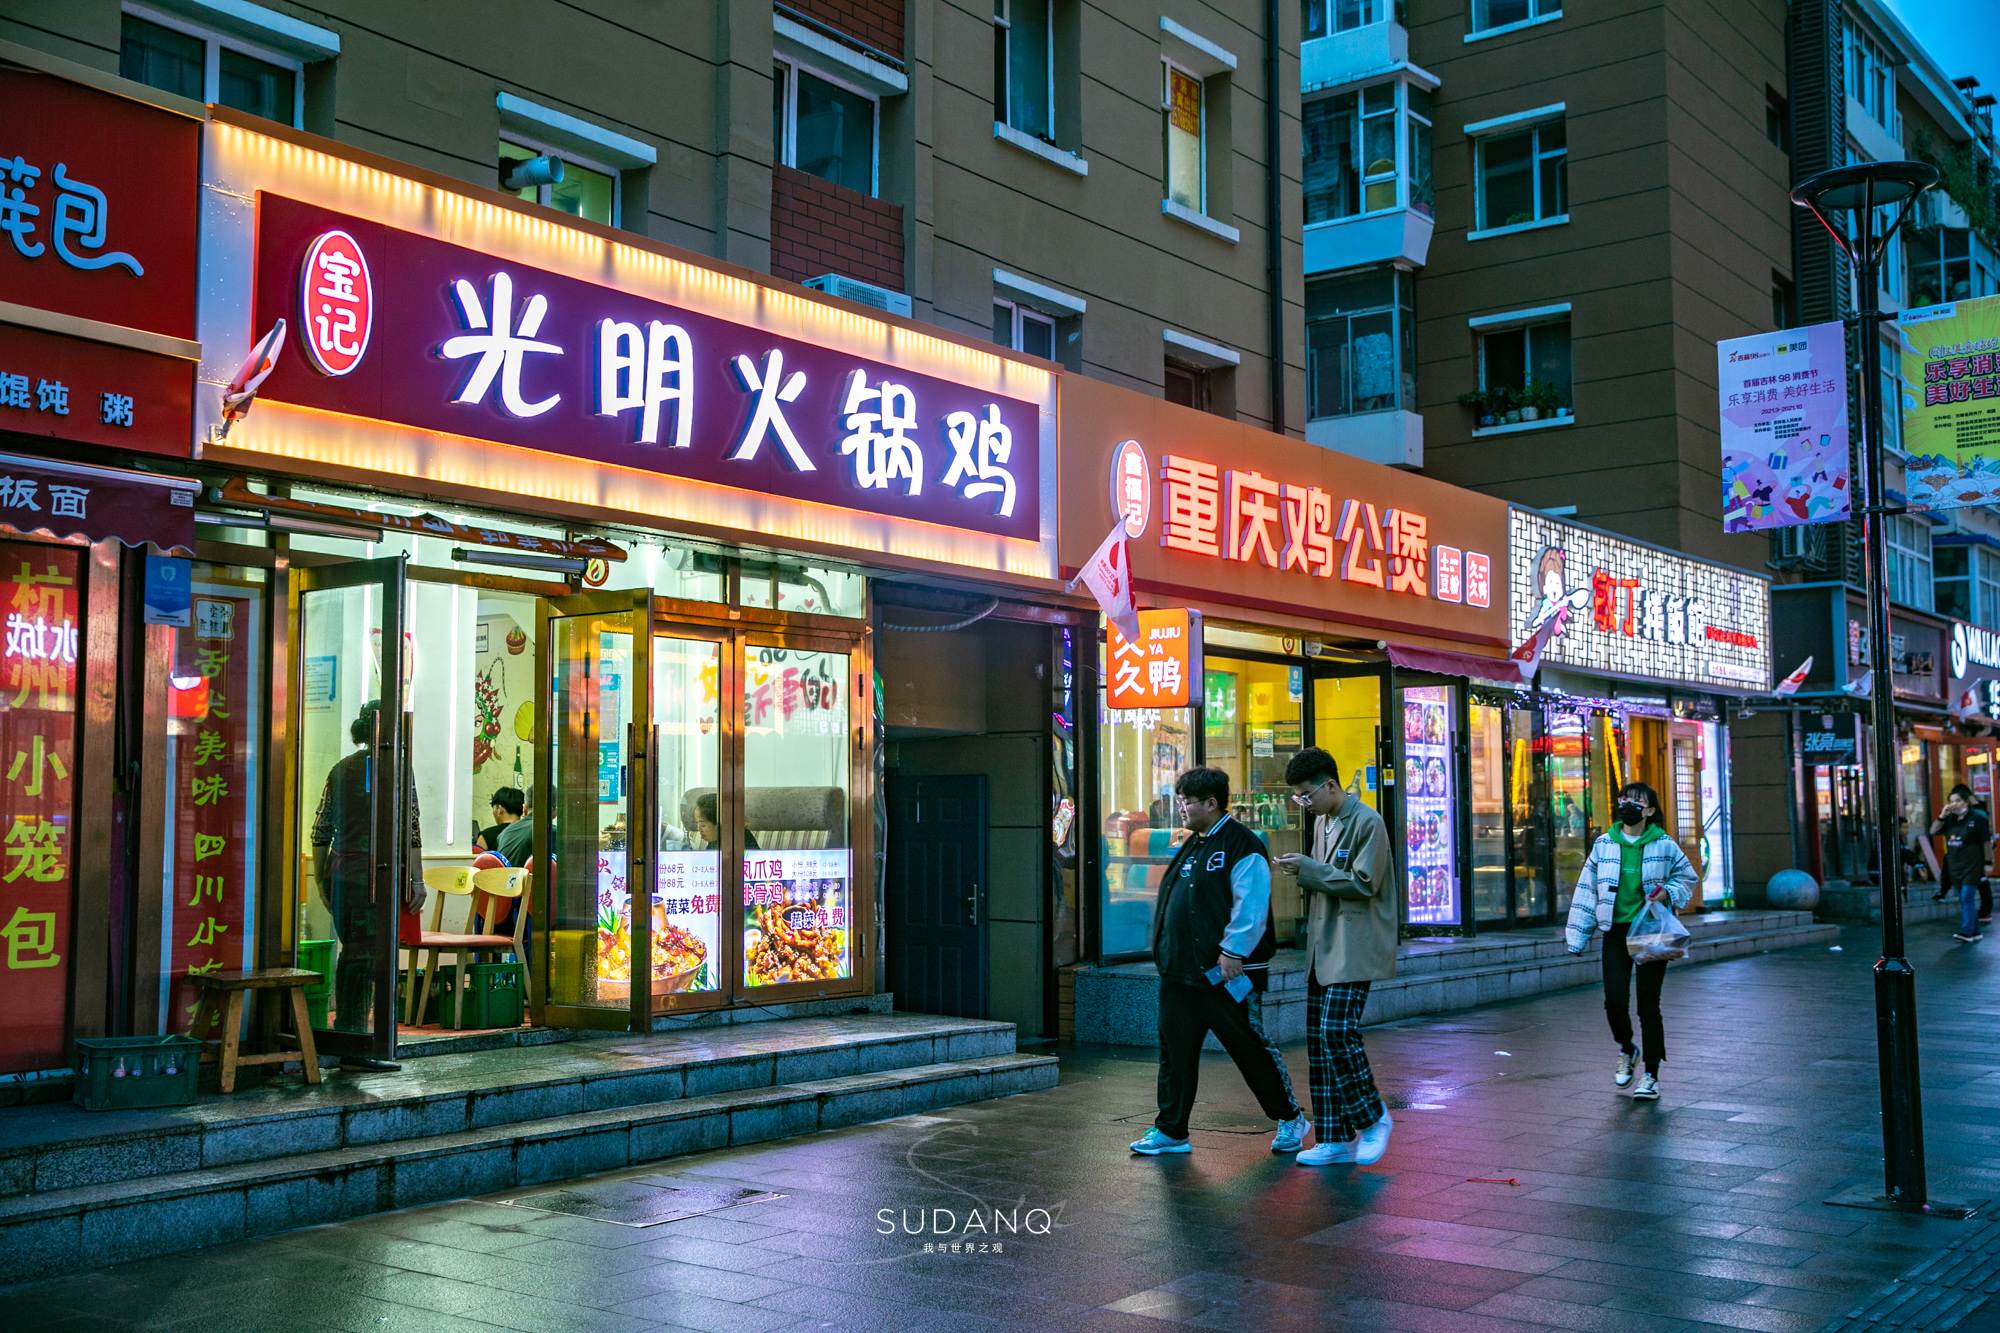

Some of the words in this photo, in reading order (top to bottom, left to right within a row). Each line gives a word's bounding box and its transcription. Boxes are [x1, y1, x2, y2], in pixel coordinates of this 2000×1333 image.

[315, 251, 361, 356] 宝记
[1789, 342, 1807, 352] 美团
[1743, 376, 1777, 388] 首届吉林
[1779, 374, 1791, 382] 98
[1793, 369, 1819, 381] 消费节
[1926, 353, 2000, 382] 乐享消
[440, 272, 1013, 518] 光明火锅鸡
[1728, 388, 1778, 407] 乐享消费
[1783, 379, 1835, 400] 美好生活
[1926, 377, 2000, 406] 美好生
[101, 392, 134, 427] 粥
[1761, 404, 1803, 415] 2021.9-2021.10
[0, 475, 90, 520] 板面
[1125, 452, 1143, 526] 鑫福记
[1160, 455, 1429, 597] 重庆鸡公煲
[1149, 627, 1181, 640] JIUJIU
[1149, 643, 1164, 655] YA
[192, 647, 230, 806] 舌尖美味
[1804, 732, 1836, 751] 张亮
[0, 561, 73, 969] 杭州小笼包
[666, 894, 721, 915] 蔬菜免费
[790, 908, 844, 929] 蔬菜免费
